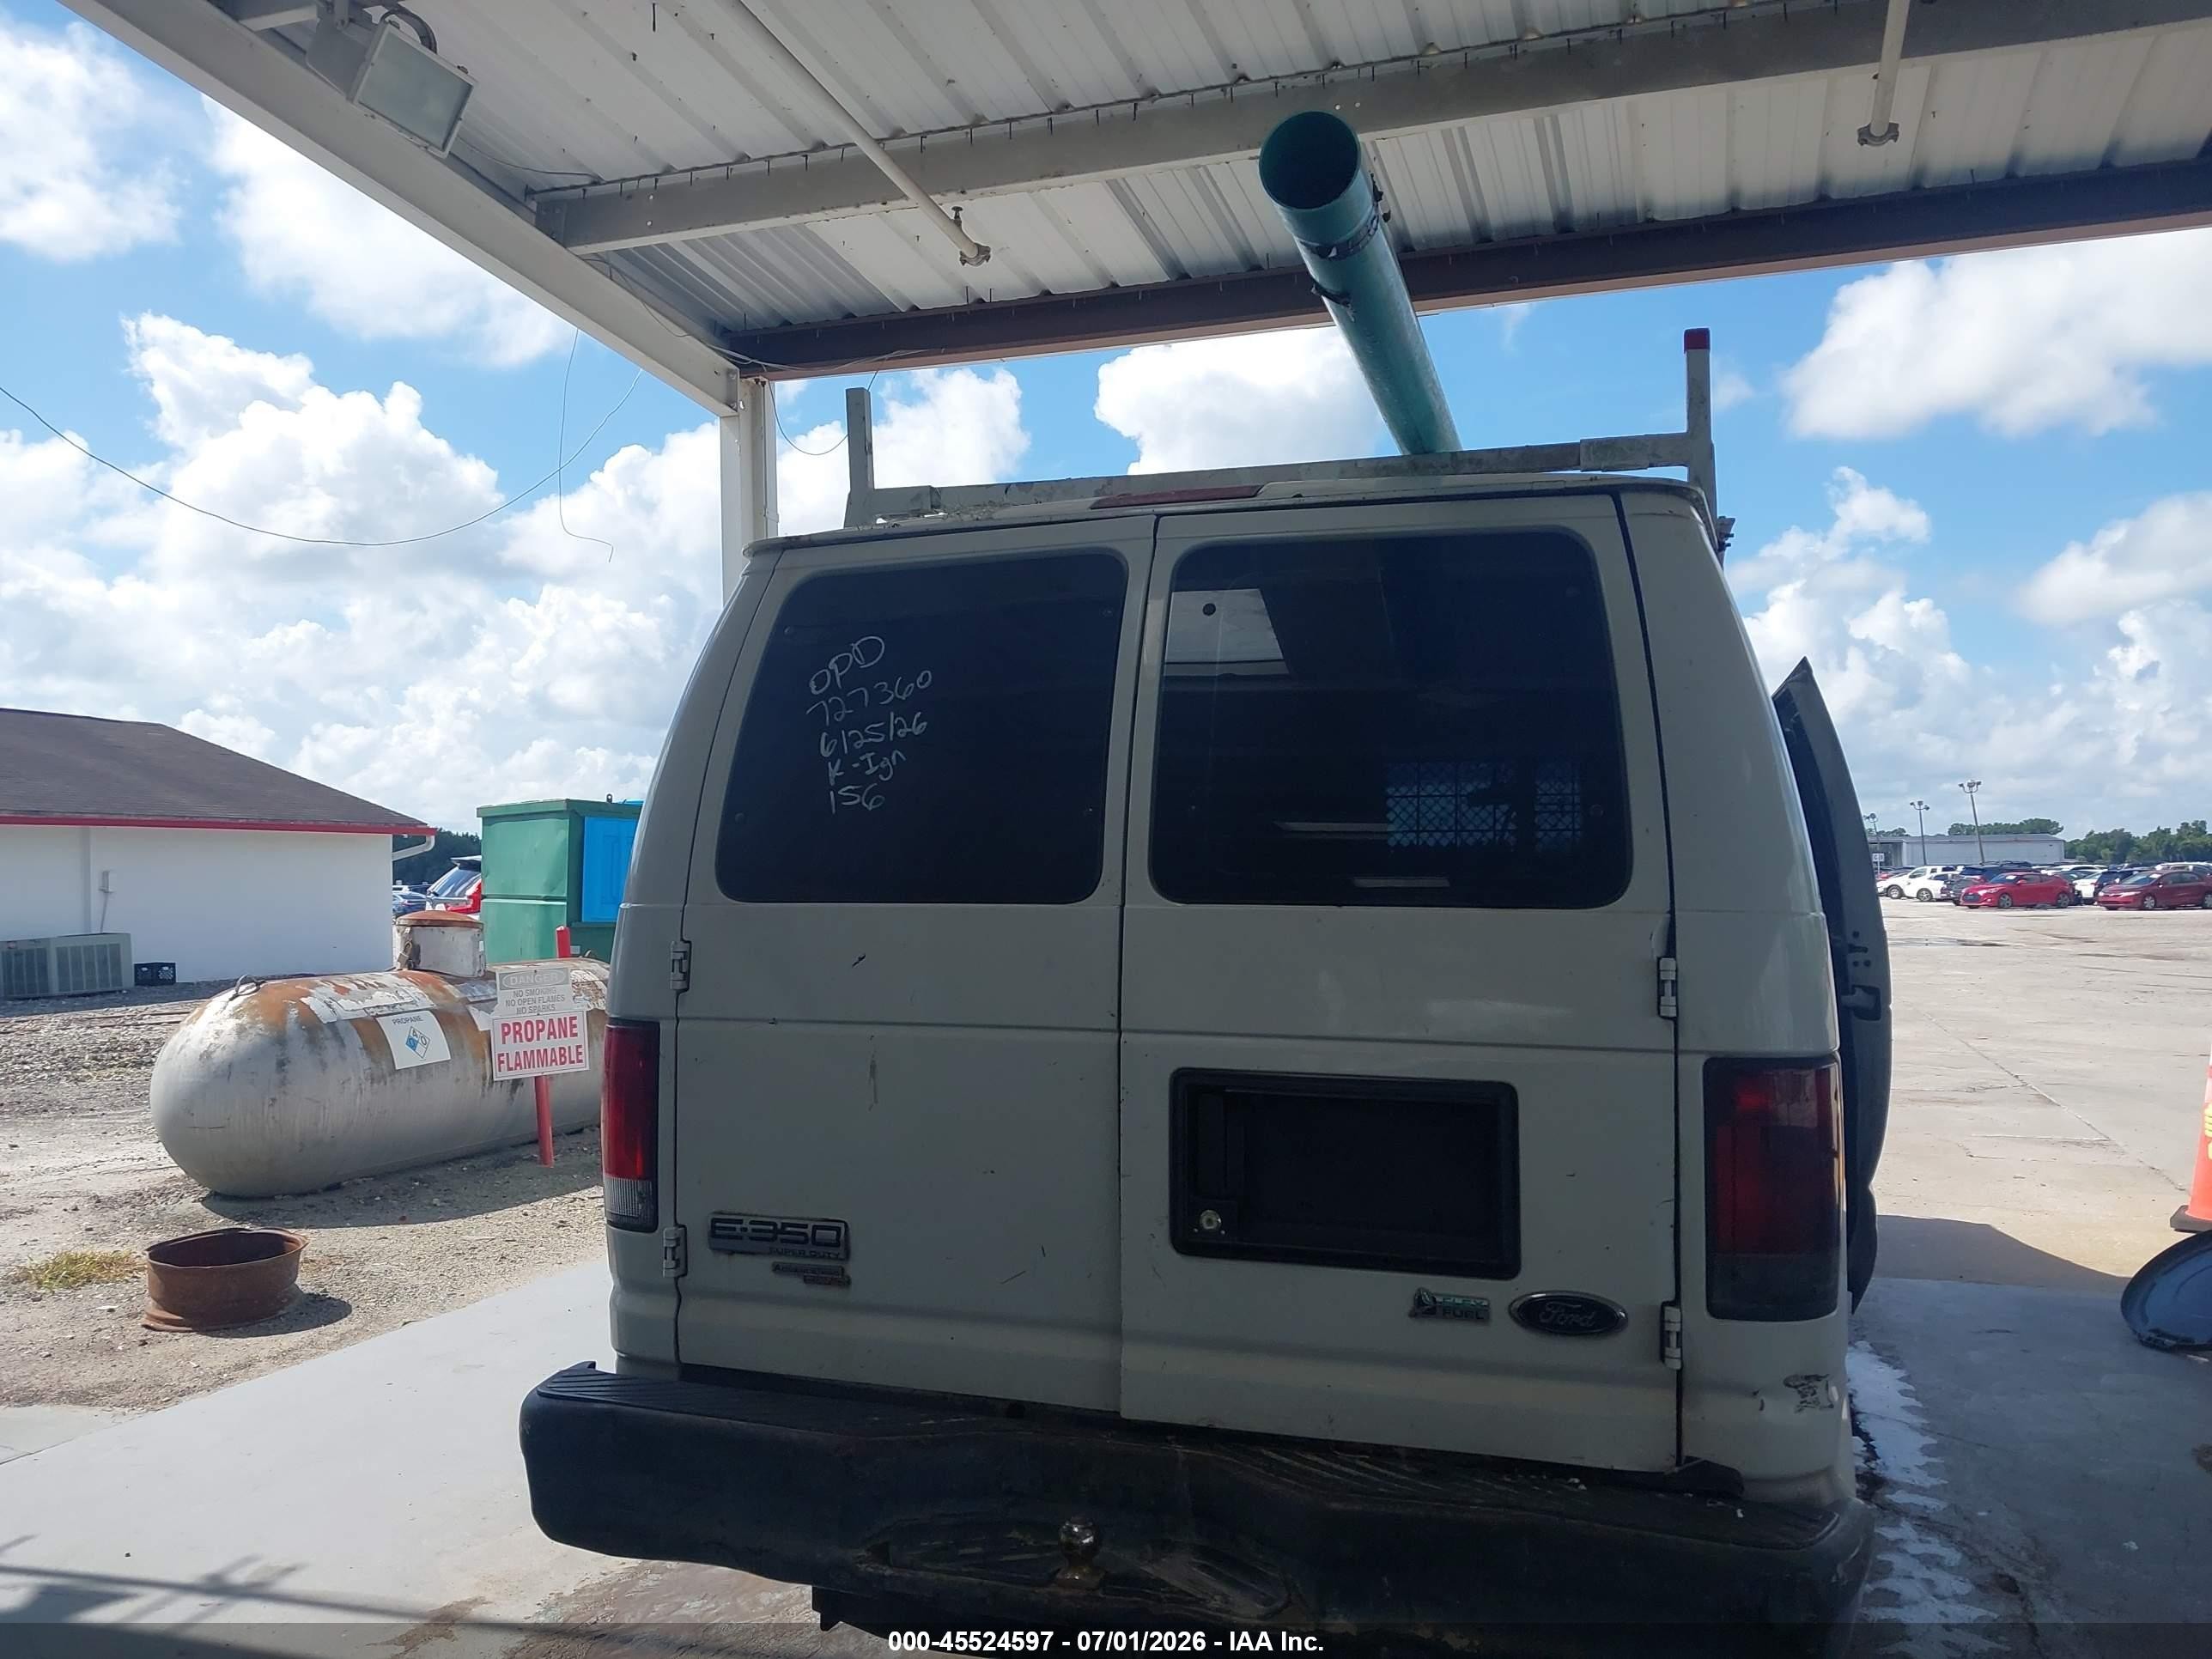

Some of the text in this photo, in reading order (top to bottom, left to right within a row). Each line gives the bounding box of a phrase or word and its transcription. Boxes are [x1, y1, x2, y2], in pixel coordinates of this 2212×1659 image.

[810, 636, 884, 695] OPD
[806, 670, 932, 726] 727360
[510, 972, 559, 986] DANGER
[514, 987, 556, 998] NO SMOKING
[506, 994, 565, 1007] NO OPEN FLAMES
[528, 1004, 556, 1013] SPARKS
[392, 1015, 423, 1025] PROPANE
[501, 1016, 579, 1045] PROPANE
[496, 1044, 584, 1073] FLAMMABLE
[1442, 1307, 1485, 1320] FUEL
[1539, 1300, 1595, 1328] Ford
